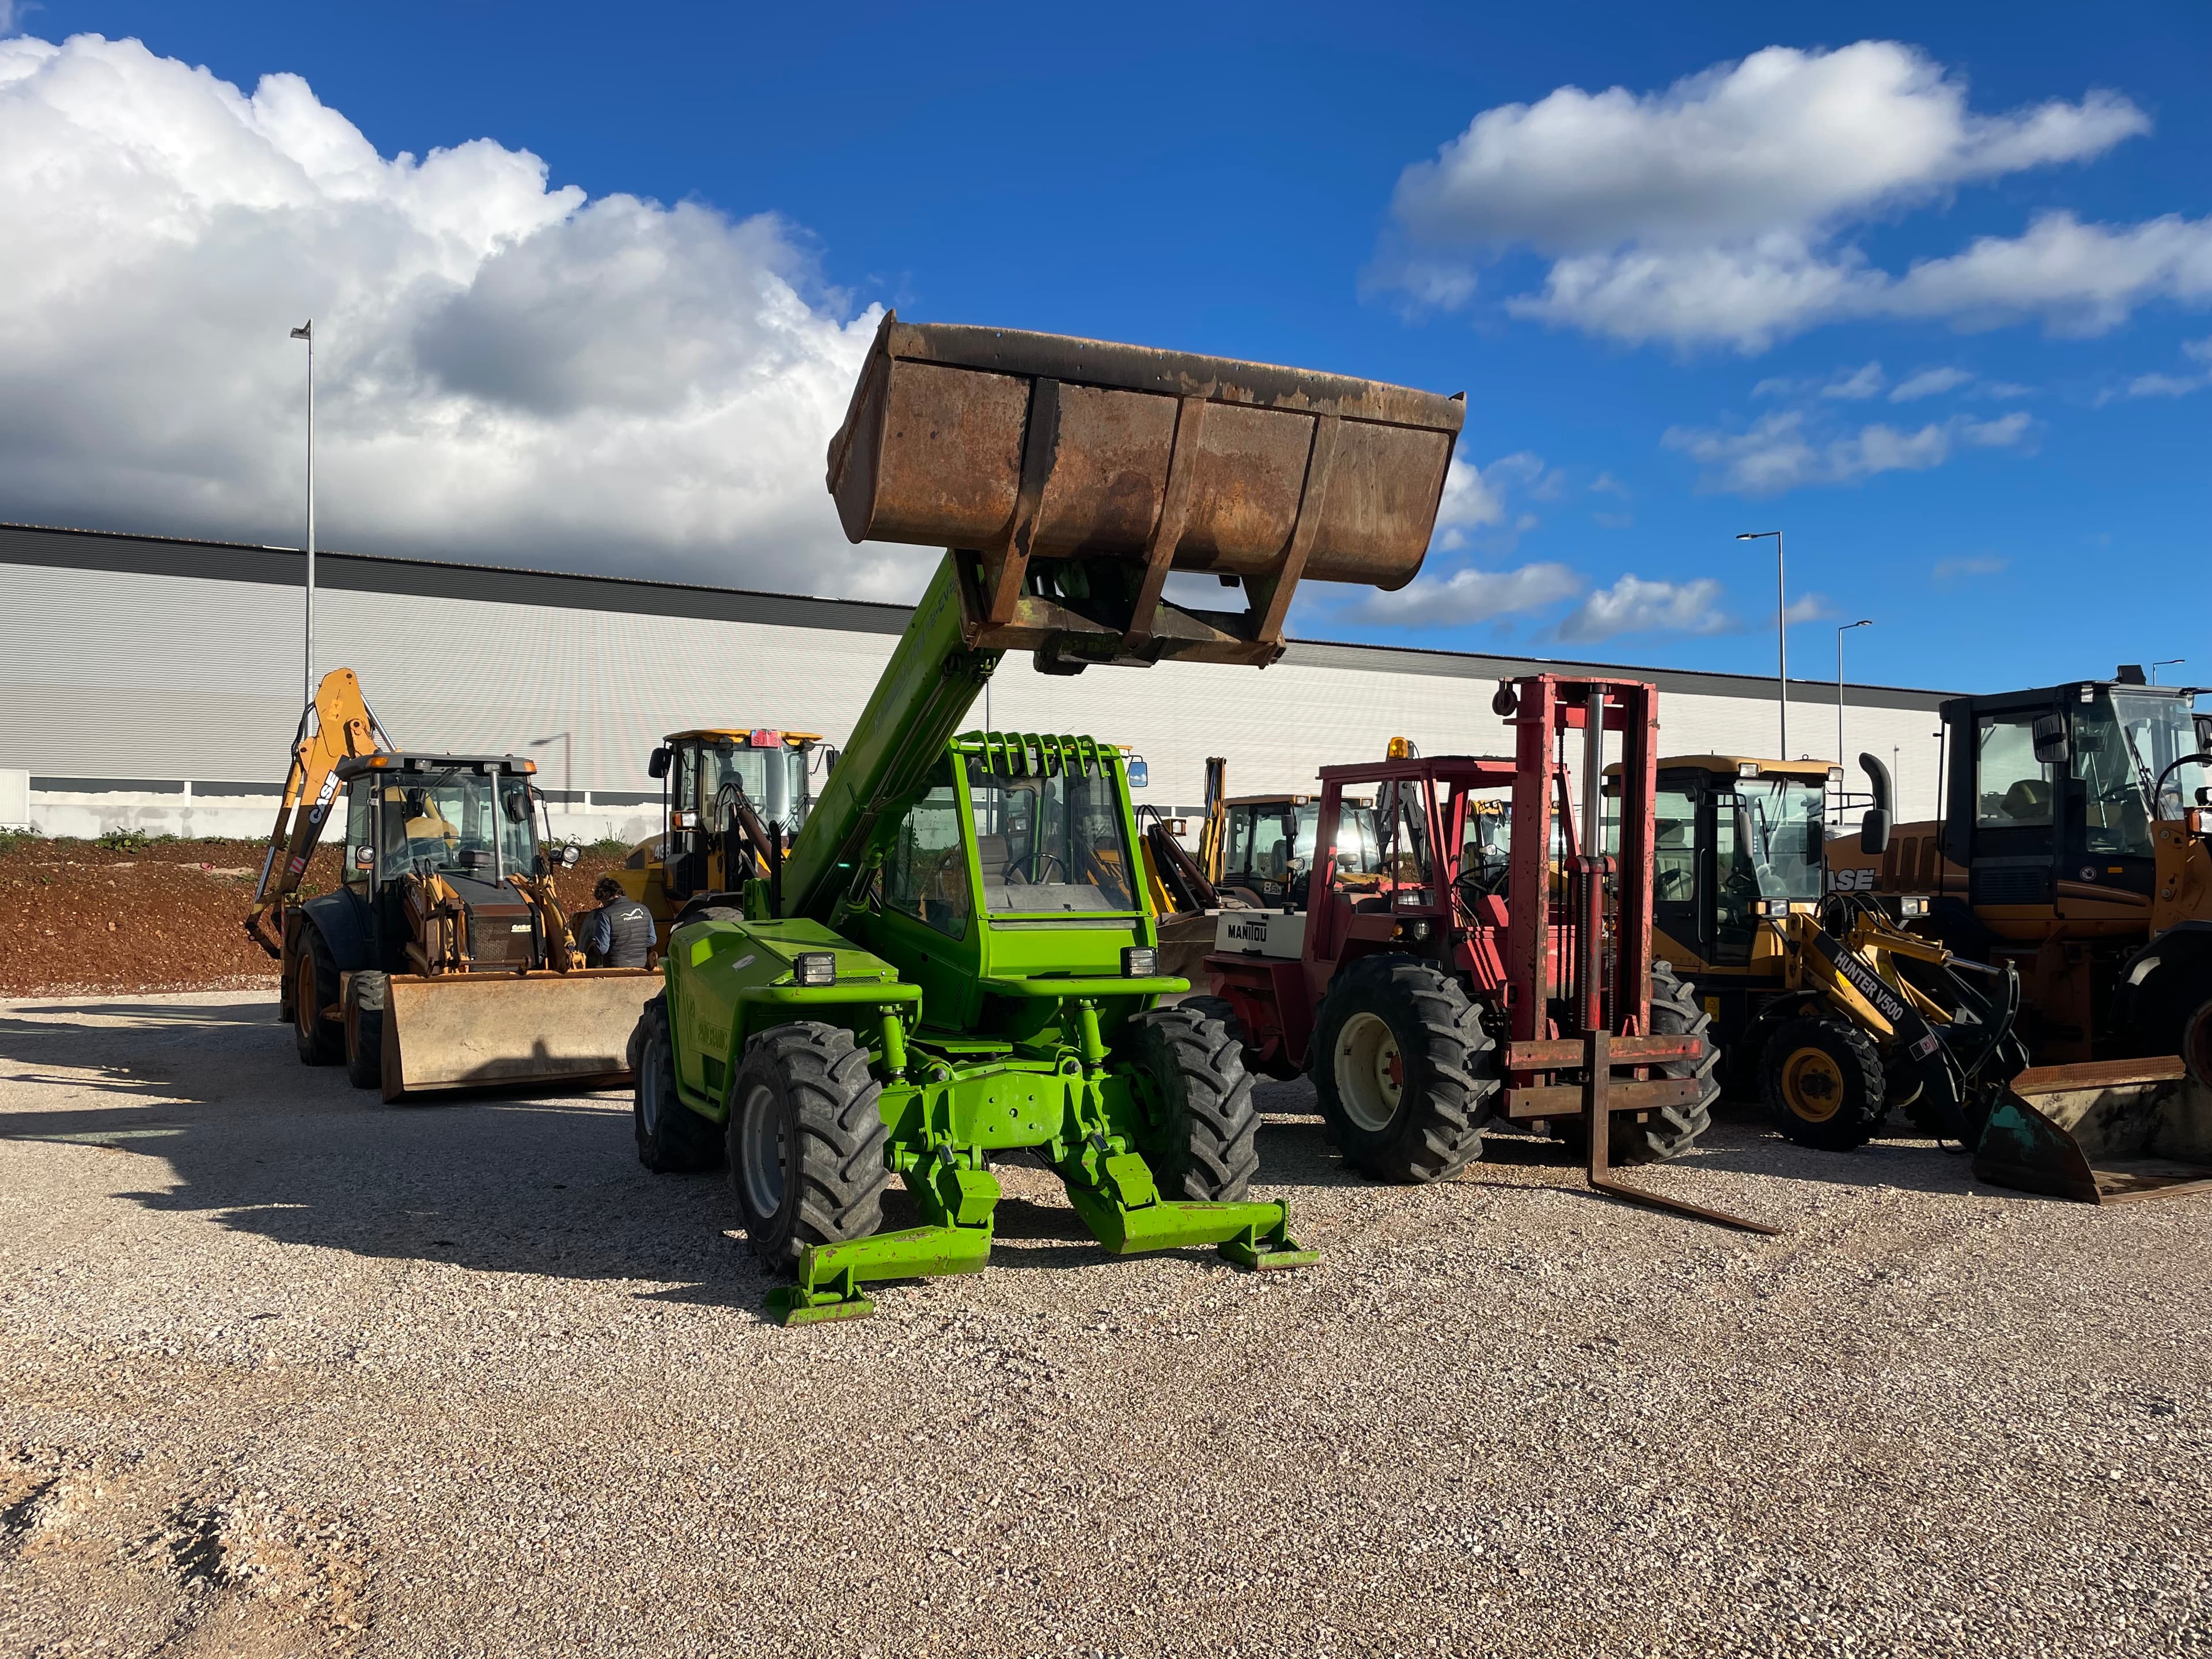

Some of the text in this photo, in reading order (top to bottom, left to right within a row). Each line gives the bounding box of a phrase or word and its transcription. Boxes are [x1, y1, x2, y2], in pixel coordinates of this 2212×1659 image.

[753, 736, 765, 745] SJ
[309, 770, 340, 824] CASE
[1828, 869, 1875, 891] SE
[1228, 921, 1267, 942] MANITOU
[1834, 950, 1904, 1021] HUNTER V500
